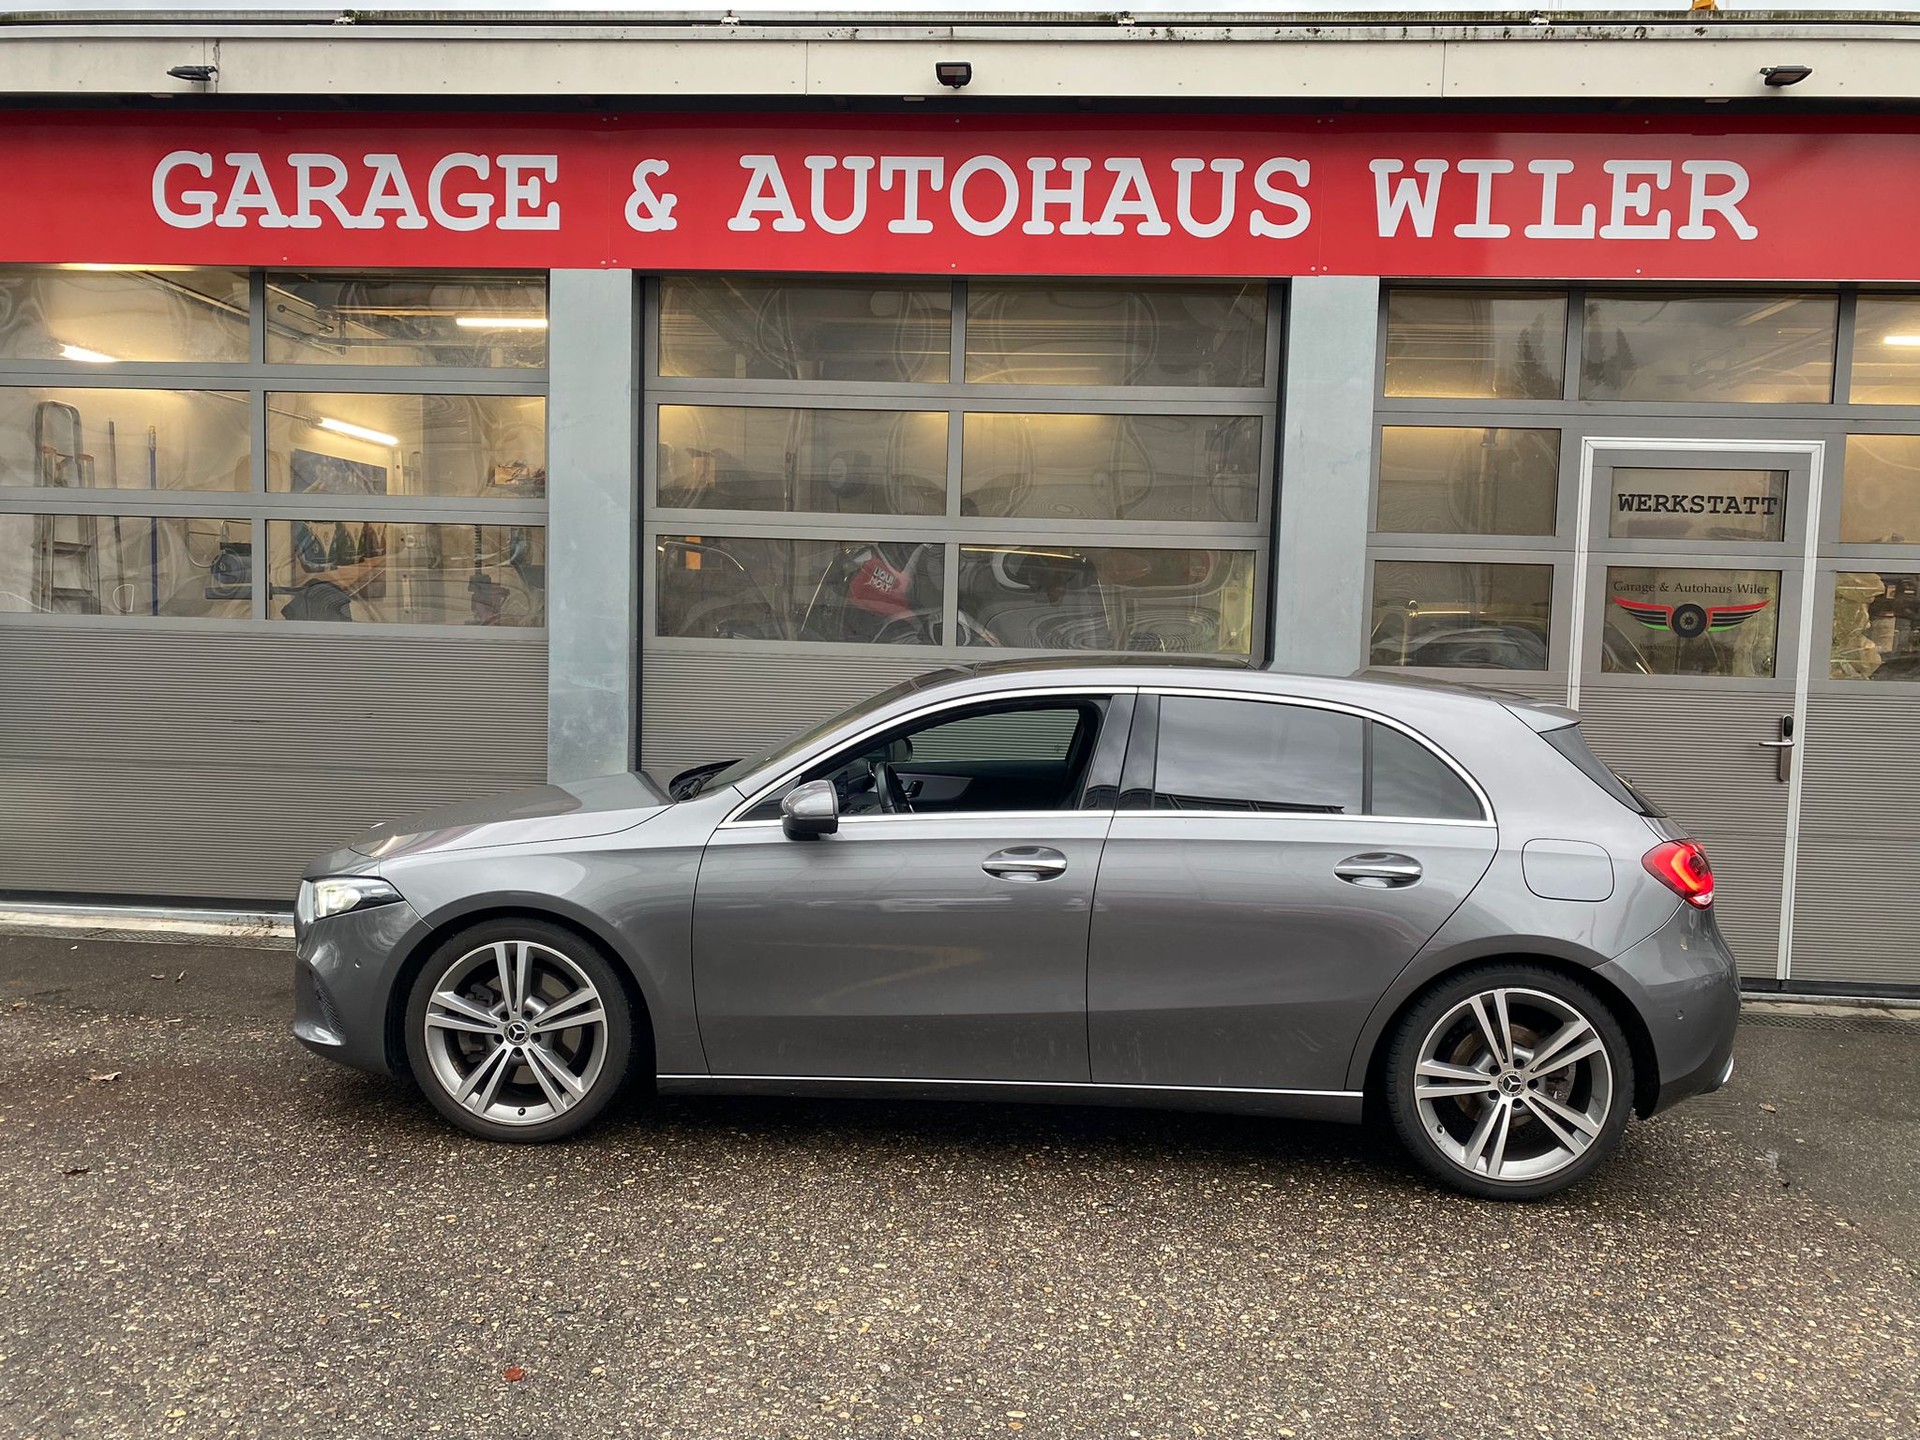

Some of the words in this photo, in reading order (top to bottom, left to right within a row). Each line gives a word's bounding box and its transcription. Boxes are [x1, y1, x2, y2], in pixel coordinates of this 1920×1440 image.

[152, 150, 560, 232] GARAGE
[624, 158, 678, 233] &
[727, 154, 1311, 239] AUTOHAUS
[1369, 158, 1759, 241] WILER
[1618, 493, 1778, 515] WERKSTATT
[869, 575, 892, 593] MOLY
[873, 567, 895, 585] LIQUI
[1613, 581, 1655, 594] Garage
[1659, 582, 1669, 592] &
[1675, 583, 1733, 594] Autohaus
[1737, 583, 1769, 594] Wiler
